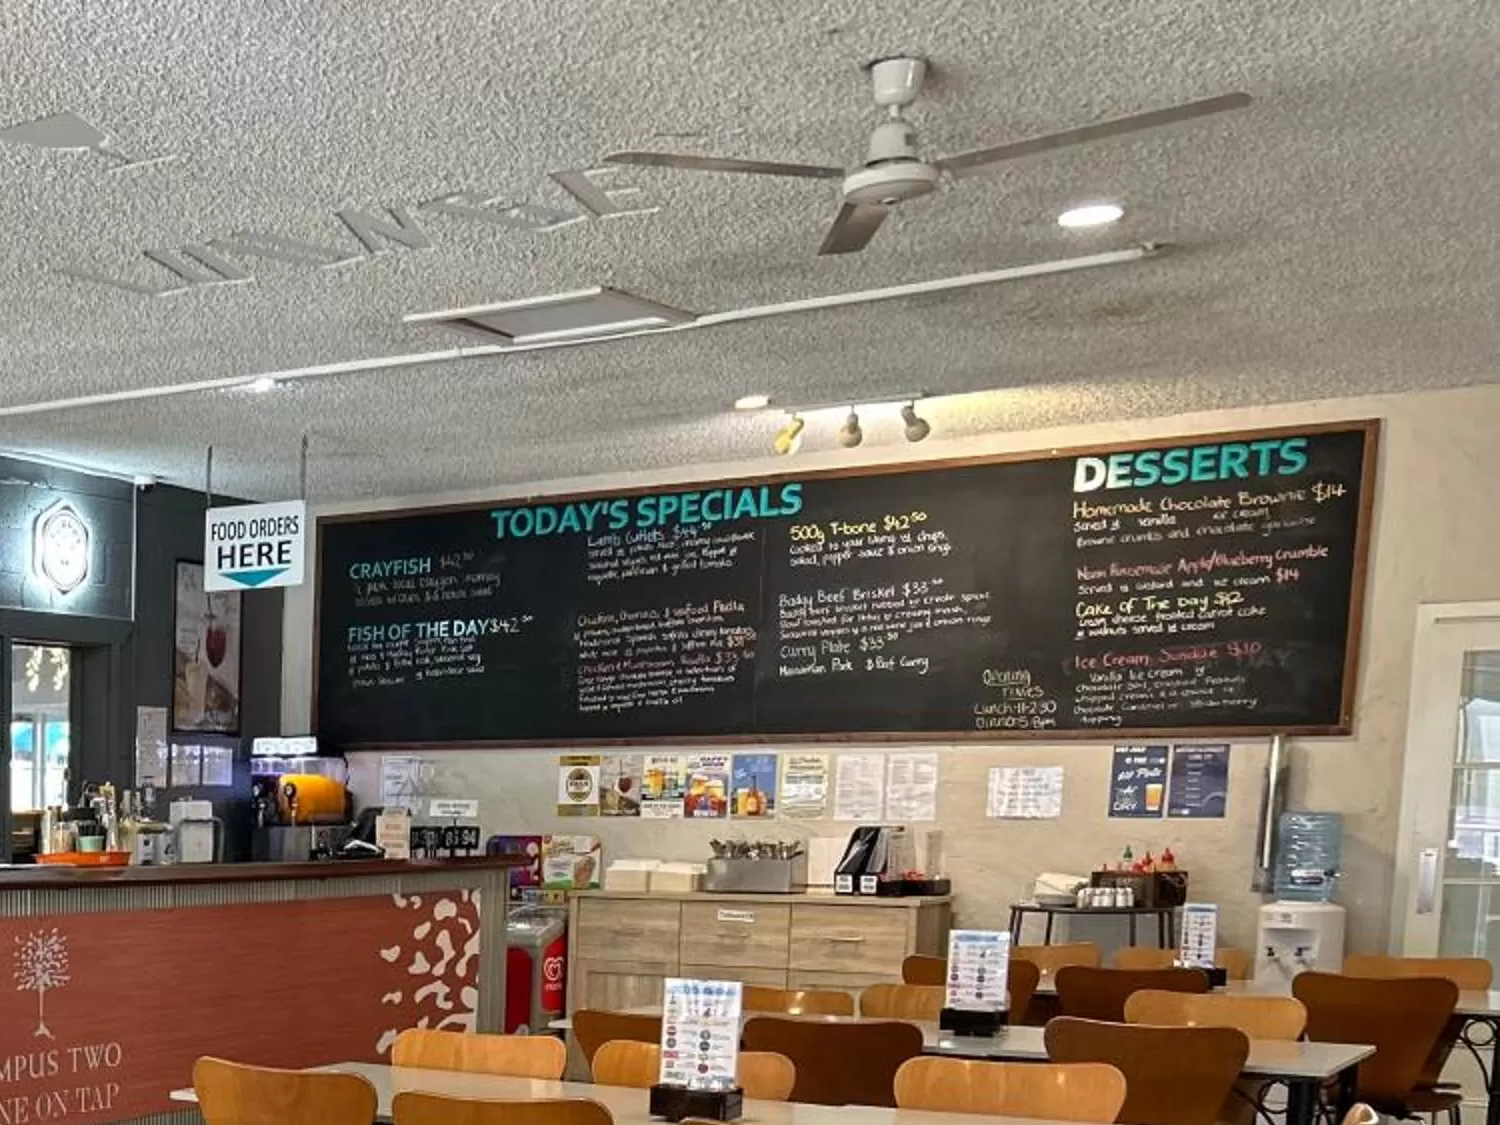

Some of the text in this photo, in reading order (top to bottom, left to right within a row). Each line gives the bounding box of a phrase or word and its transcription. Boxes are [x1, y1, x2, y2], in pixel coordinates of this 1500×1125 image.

[1073, 438, 1308, 493] DESSERTS
[492, 484, 802, 539] TODAY'S SPECIALS
[1073, 482, 1347, 519] Homemade Chocolate Brownie $14
[212, 515, 299, 541] FOOD ORDERS
[789, 524, 825, 544] 500g
[829, 521, 877, 536] T-bone
[217, 540, 292, 569] HERE
[349, 557, 431, 579] CRAYFISH
[1275, 567, 1300, 584] $14
[817, 589, 845, 603] Beef
[852, 586, 895, 601] Brisket
[1075, 601, 1112, 618] Cake
[1119, 598, 1138, 614] of
[1142, 595, 1171, 611] The
[349, 625, 385, 642] FISH
[387, 623, 411, 640] OF
[416, 620, 449, 638] THE
[453, 619, 489, 636] DAY
[779, 645, 816, 664] Curry
[821, 640, 851, 655] Plate
[1075, 654, 1098, 670] Ice
[1103, 652, 1150, 668] Cream
[900, 656, 930, 675] Curry
[67, 1042, 122, 1073] TWO
[36, 1089, 69, 1120] ON
[76, 1083, 120, 1113] TAP
